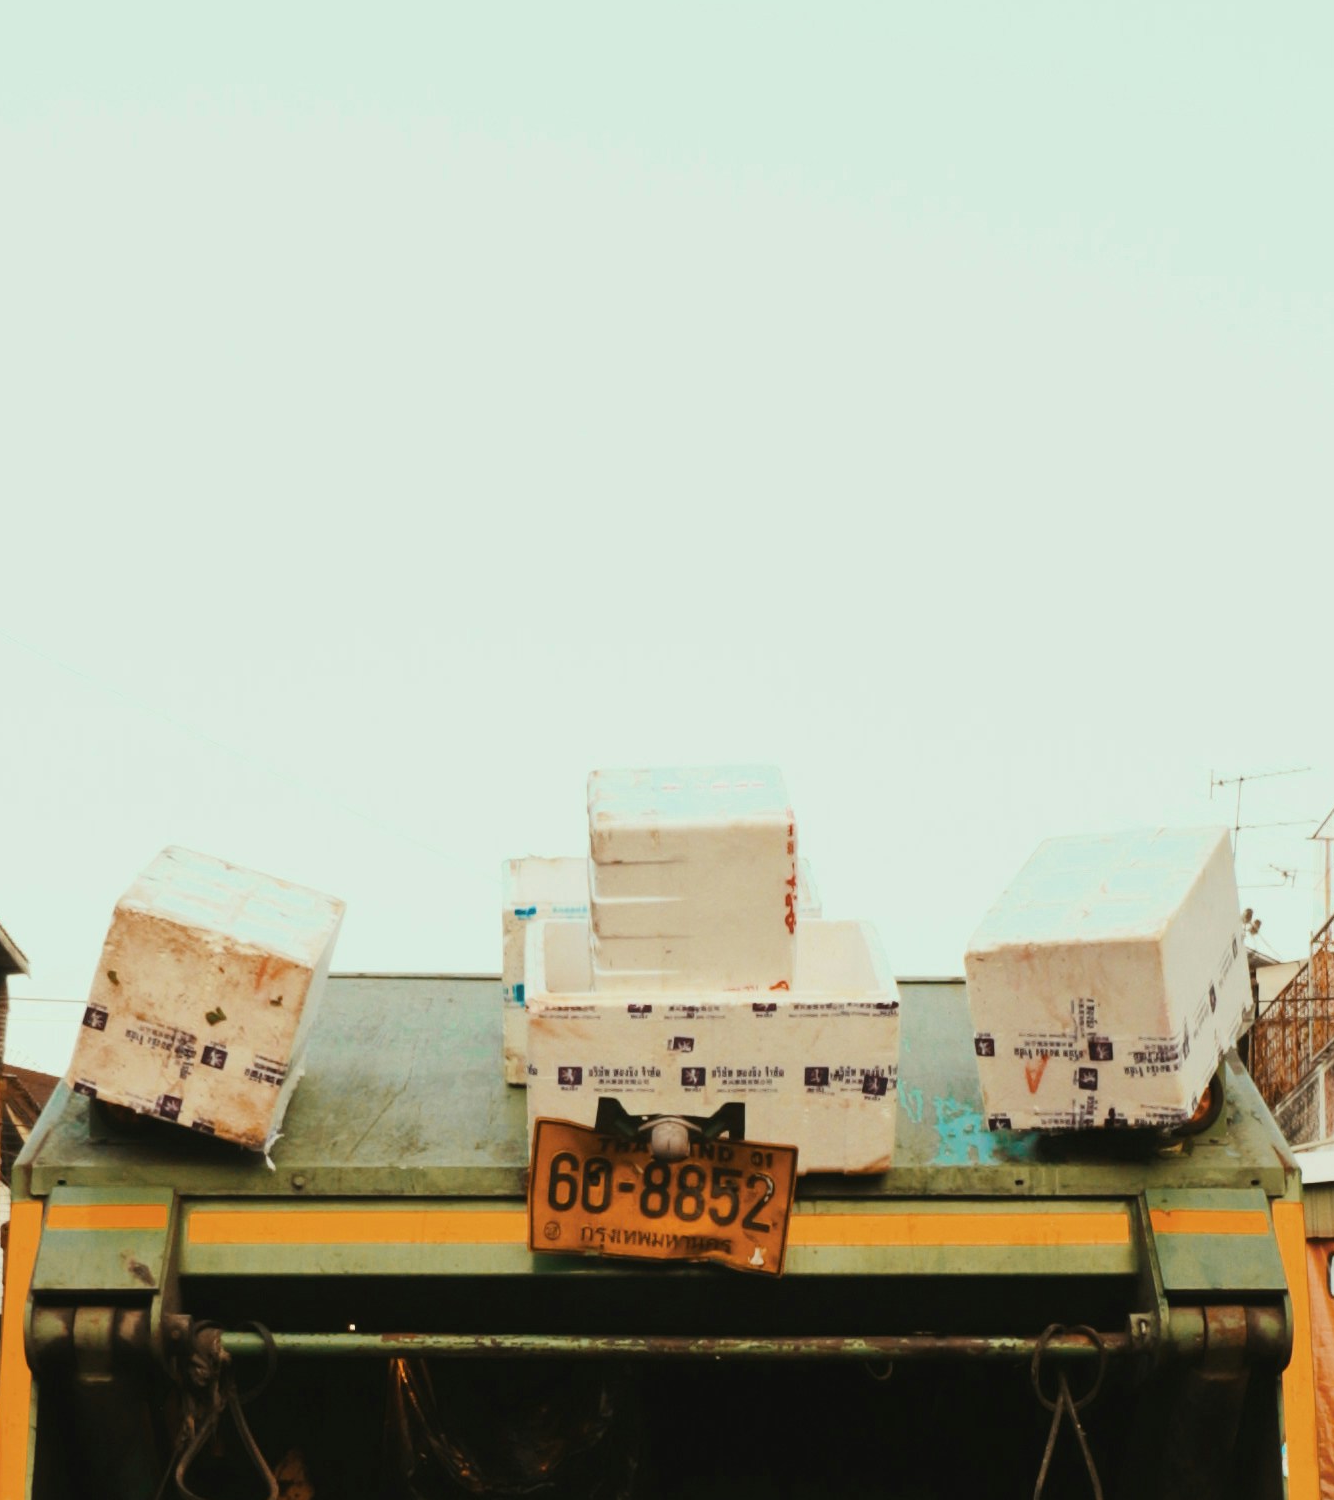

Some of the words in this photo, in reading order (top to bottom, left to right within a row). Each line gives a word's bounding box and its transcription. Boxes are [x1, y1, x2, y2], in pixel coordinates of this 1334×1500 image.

[599, 1137, 734, 1161] THAND
[580, 1224, 732, 1254] กรุงเทพมหานคร
